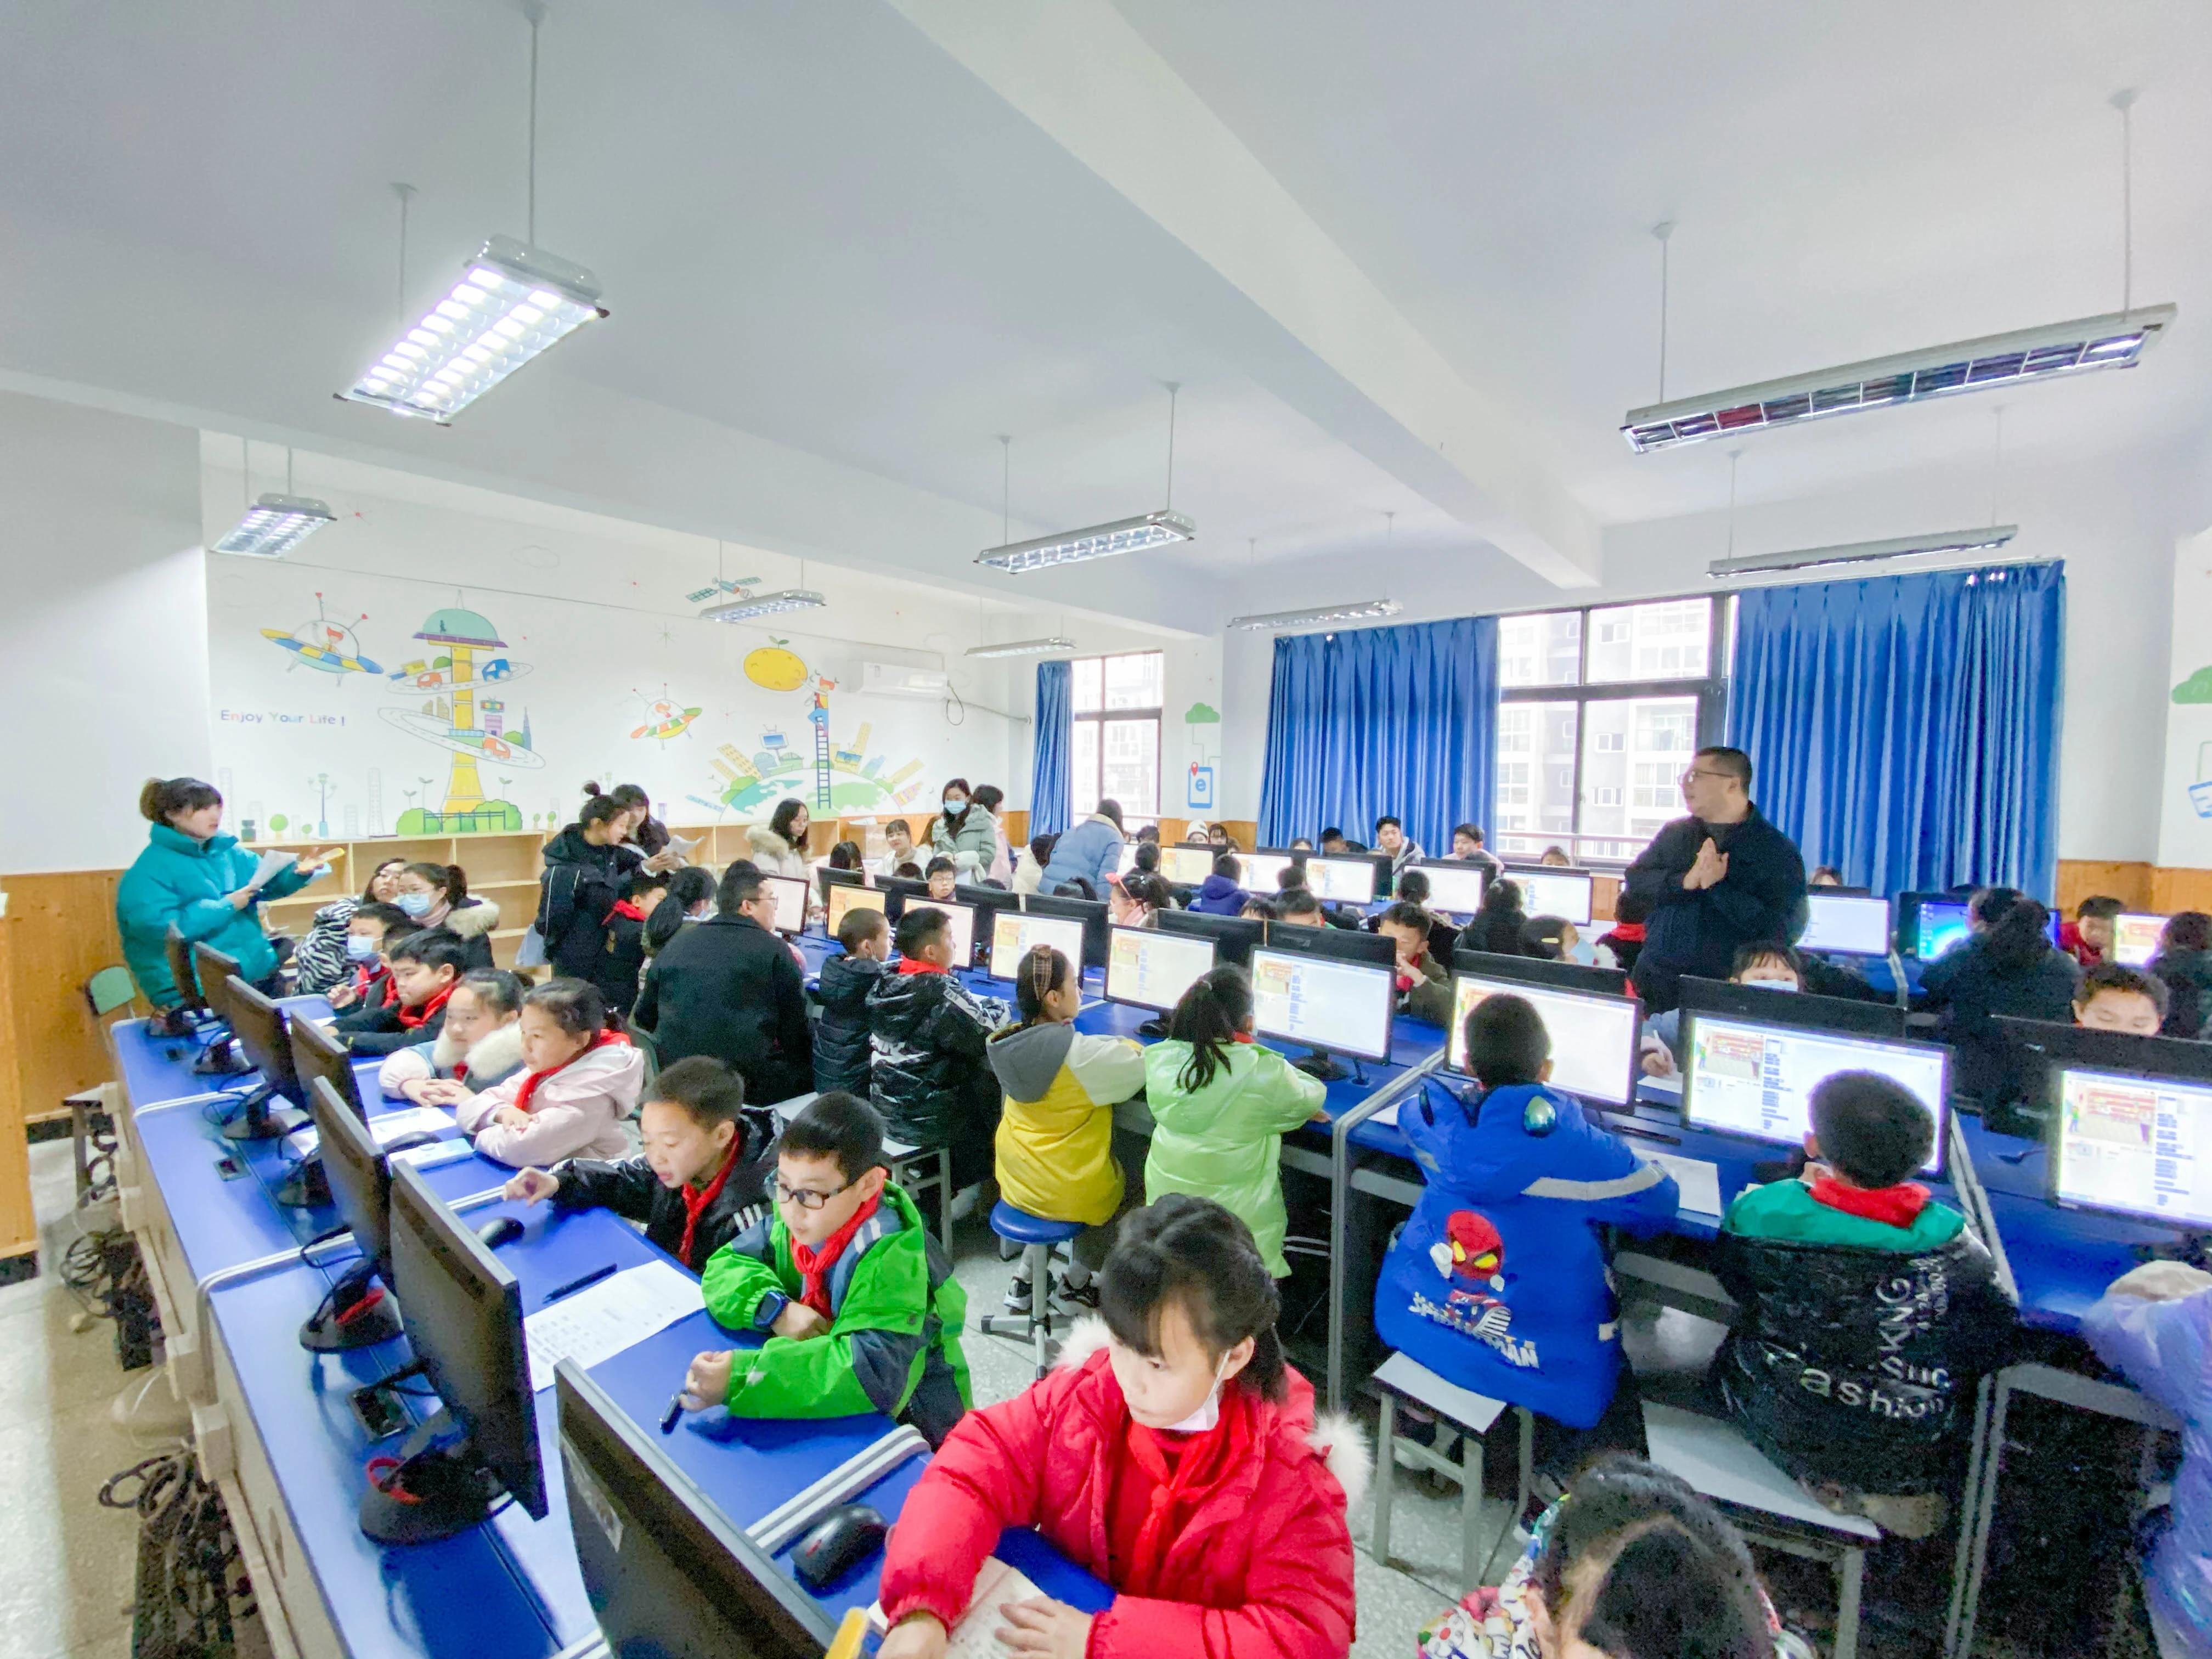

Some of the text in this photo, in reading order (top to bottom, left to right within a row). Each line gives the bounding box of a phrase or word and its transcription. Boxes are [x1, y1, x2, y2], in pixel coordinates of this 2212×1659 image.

[221, 709, 263, 724] Enjoy
[269, 712, 303, 723] Your
[309, 714, 336, 724] Life
